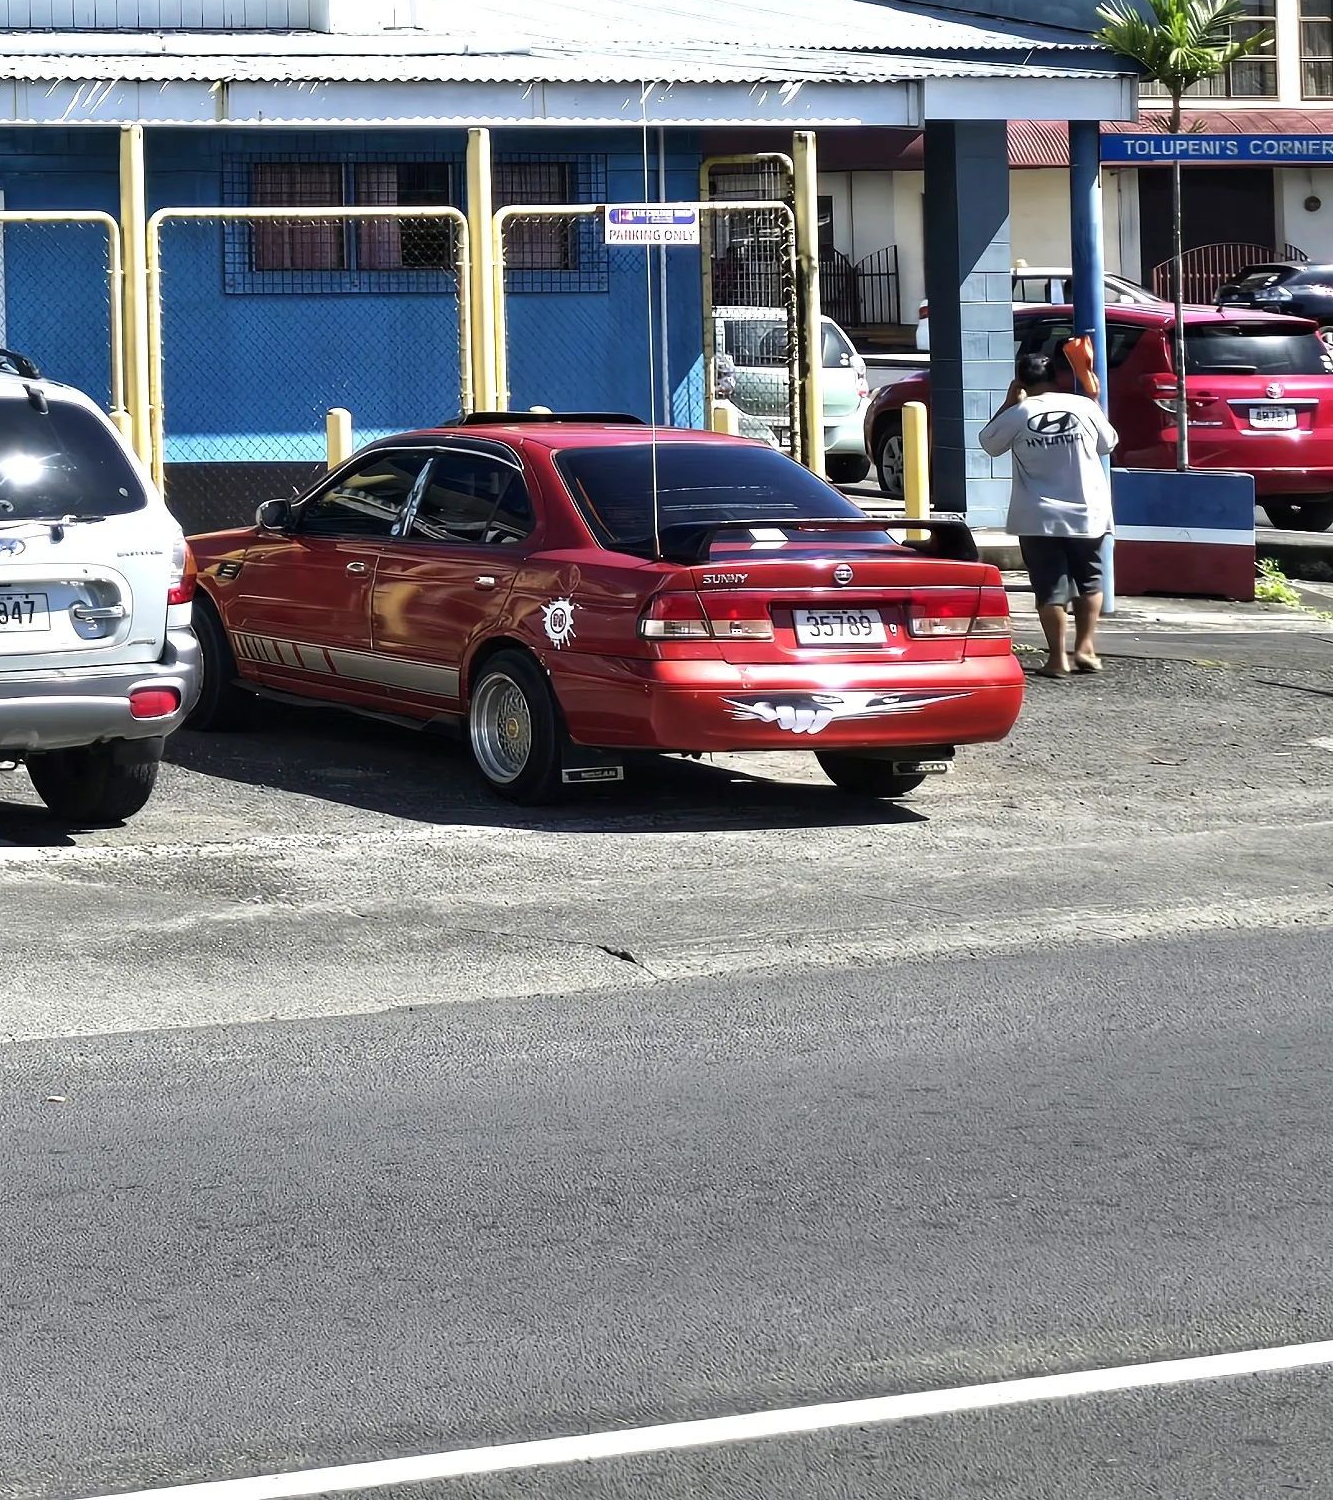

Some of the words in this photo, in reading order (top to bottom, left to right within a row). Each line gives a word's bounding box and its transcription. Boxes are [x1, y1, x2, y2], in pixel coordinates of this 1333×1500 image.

[1123, 139, 1238, 156] TOLUPENI'S
[1249, 140, 1333, 156] CORNER
[609, 229, 661, 241] PARKING
[664, 229, 695, 241] ONLY
[702, 573, 748, 584] SUNNY
[806, 614, 873, 637] 35789
